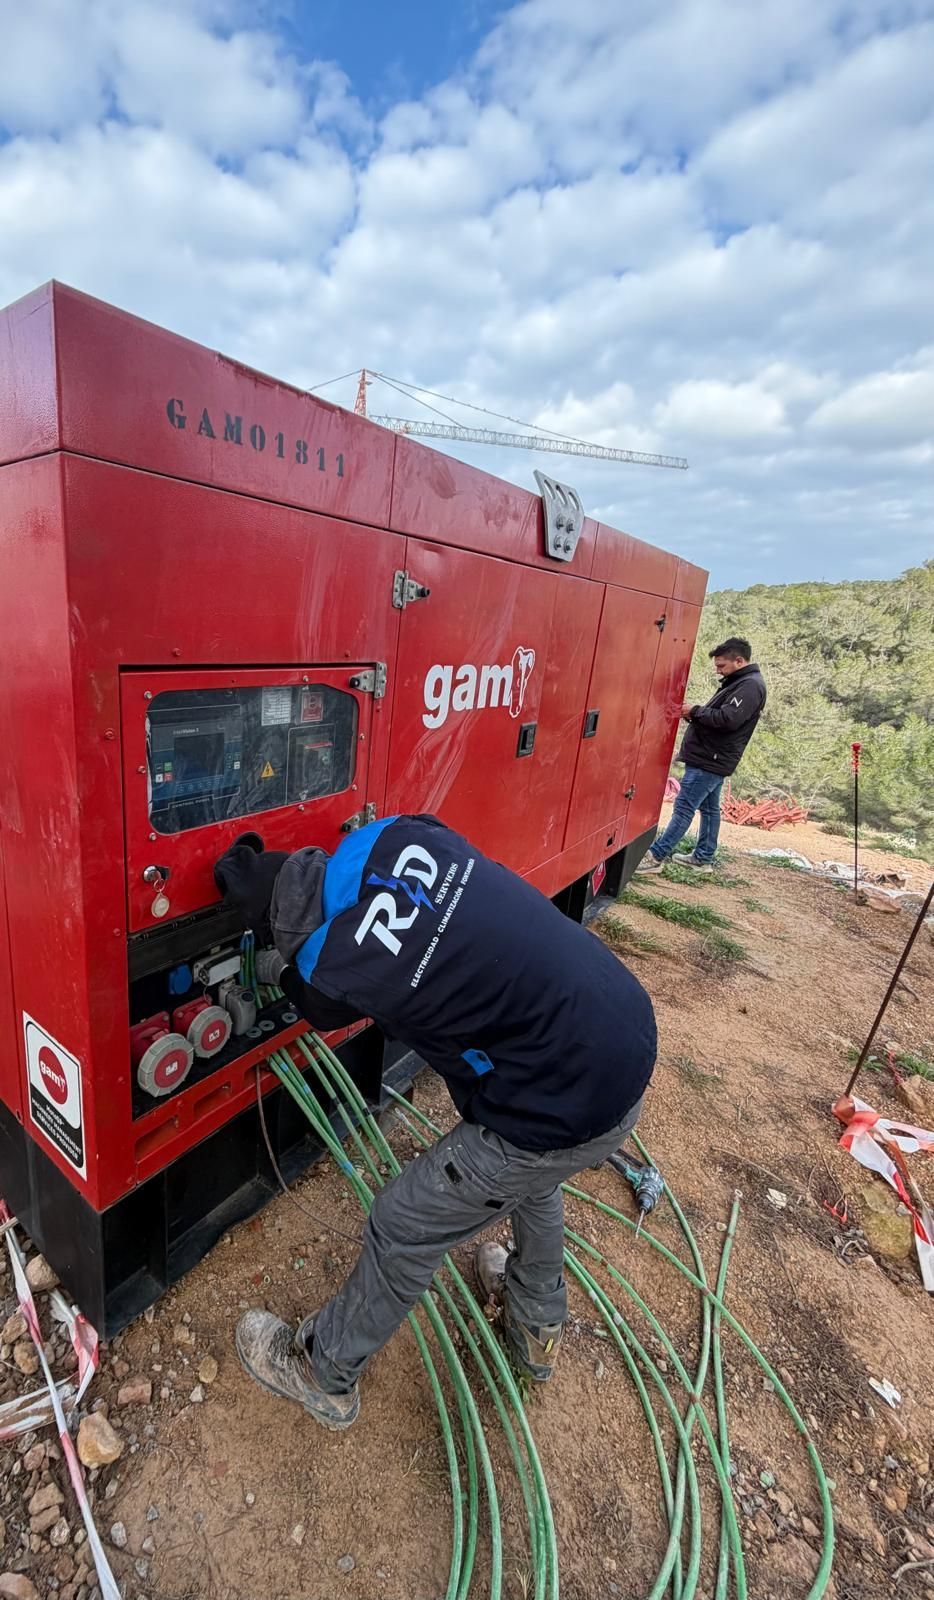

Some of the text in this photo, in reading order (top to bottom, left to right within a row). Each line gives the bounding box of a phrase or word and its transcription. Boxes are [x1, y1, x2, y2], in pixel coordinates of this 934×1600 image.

[422, 664, 513, 729] gam
[730, 696, 743, 708] N
[435, 863, 458, 904] SERVICIOS
[410, 936, 439, 988] ELECTRICIDAD
[437, 886, 464, 933] CLIMATIZACIÓN
[39, 1059, 61, 1086] gam
